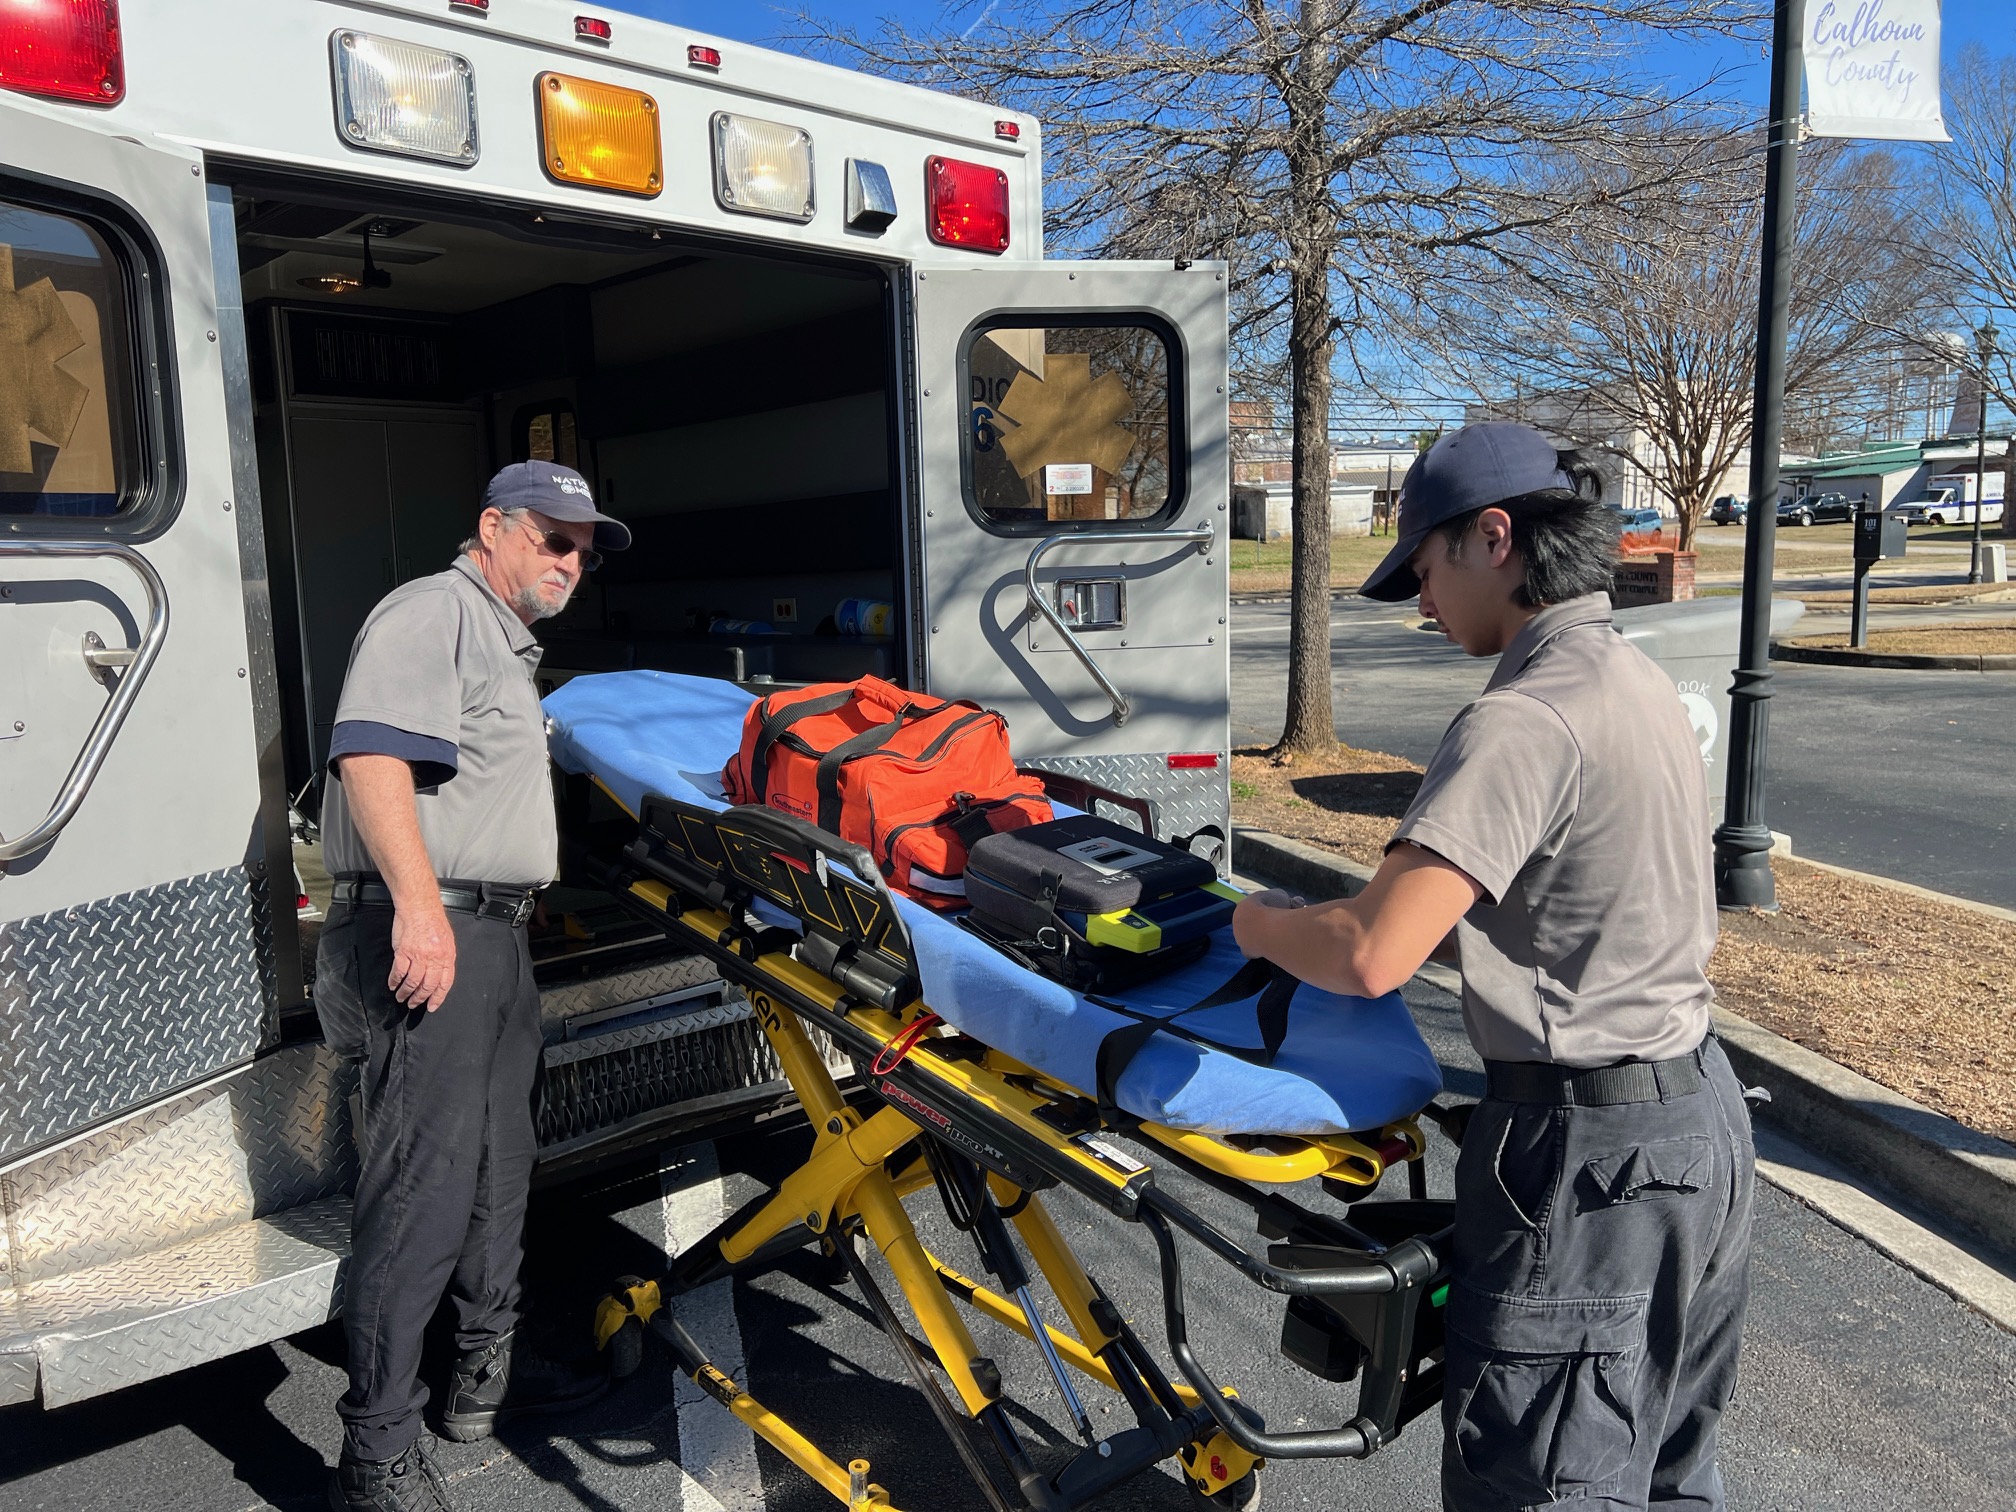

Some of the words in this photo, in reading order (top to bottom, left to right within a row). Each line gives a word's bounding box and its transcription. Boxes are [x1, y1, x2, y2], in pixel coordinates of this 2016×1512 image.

[1813, 0, 1925, 48] Calhoun
[1825, 46, 1919, 103] County
[973, 407, 995, 452] 6
[1864, 518, 1877, 527] 101
[774, 796, 813, 819] Southeastern
[881, 1080, 952, 1128] power
